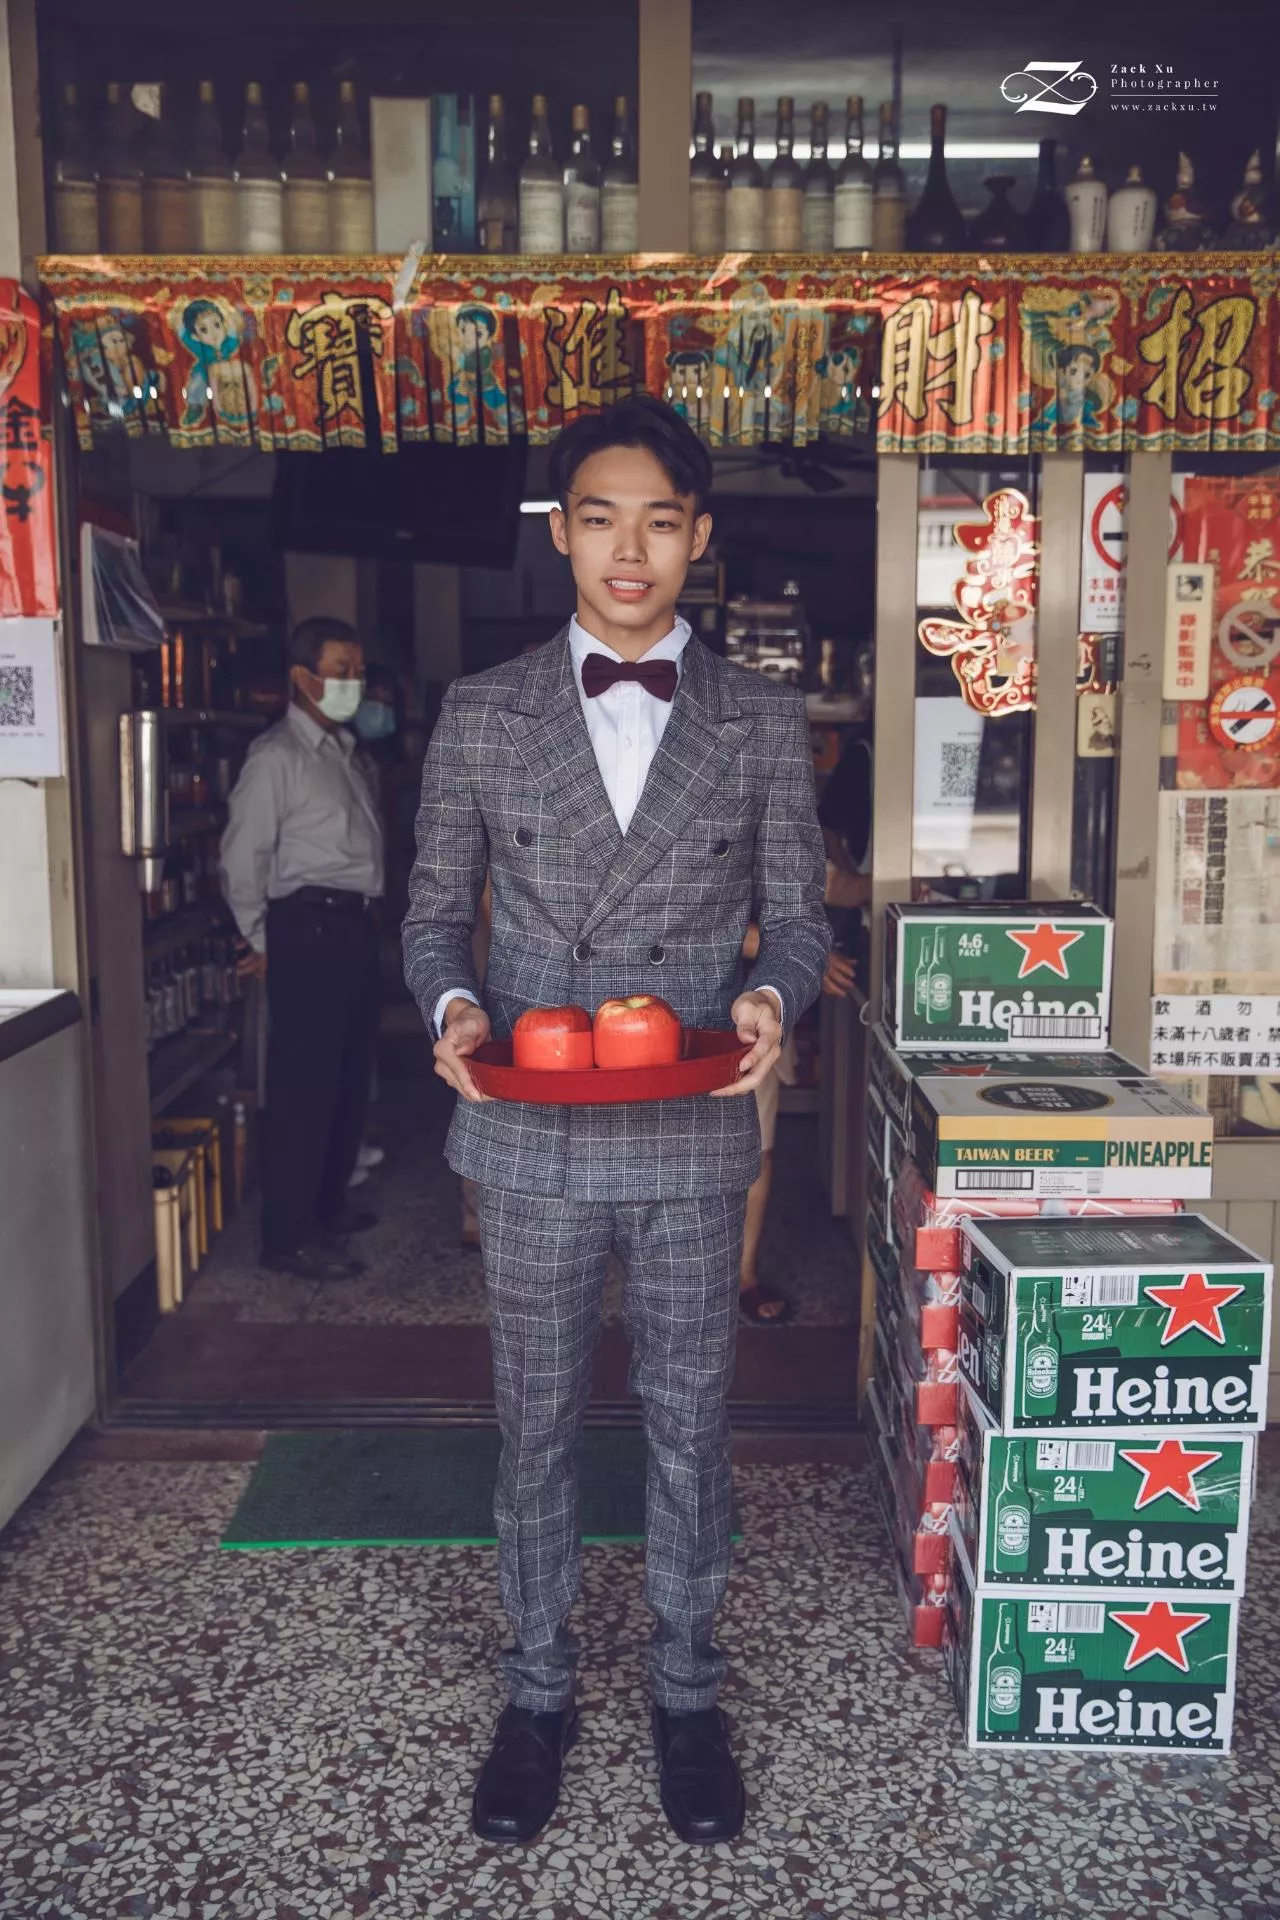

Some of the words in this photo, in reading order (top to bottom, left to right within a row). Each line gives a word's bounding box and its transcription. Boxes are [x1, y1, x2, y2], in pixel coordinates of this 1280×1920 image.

[958, 949, 981, 957] PACK
[958, 990, 1103, 1029] Heine
[1155, 999, 1280, 1016] 飲酒勿
[955, 1148, 1010, 1161] TAIWAN
[1014, 1148, 1054, 1161] BEER
[1106, 1141, 1212, 1167] PINEAPPLE
[1082, 1314, 1103, 1332] 24
[1053, 1476, 1077, 1493] 24
[1044, 1638, 1067, 1655] 24
